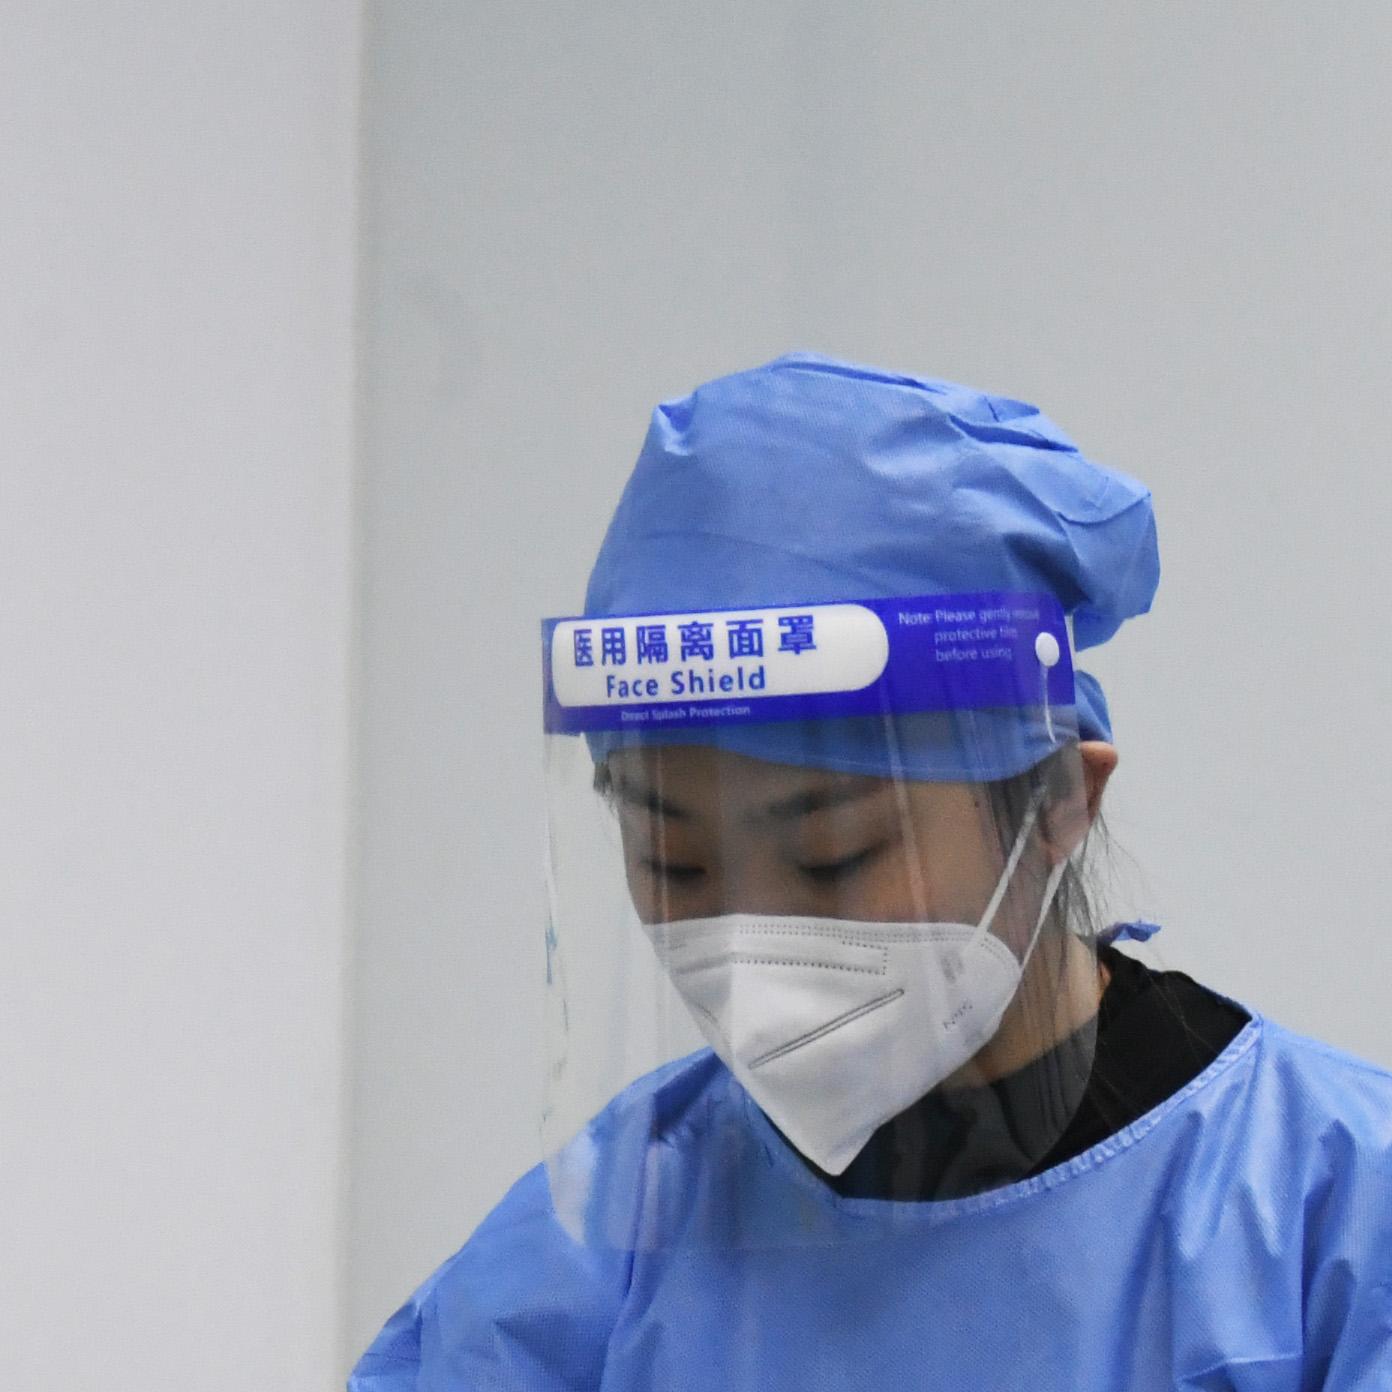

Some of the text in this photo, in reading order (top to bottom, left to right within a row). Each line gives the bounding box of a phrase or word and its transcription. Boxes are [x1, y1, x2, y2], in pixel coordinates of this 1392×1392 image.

[935, 609, 976, 622] Please
[573, 614, 817, 667] 医用隔离面罩
[934, 625, 997, 645] protective
[935, 648, 978, 662] before
[606, 665, 766, 699] Face Shield
[689, 706, 751, 718] Protection
